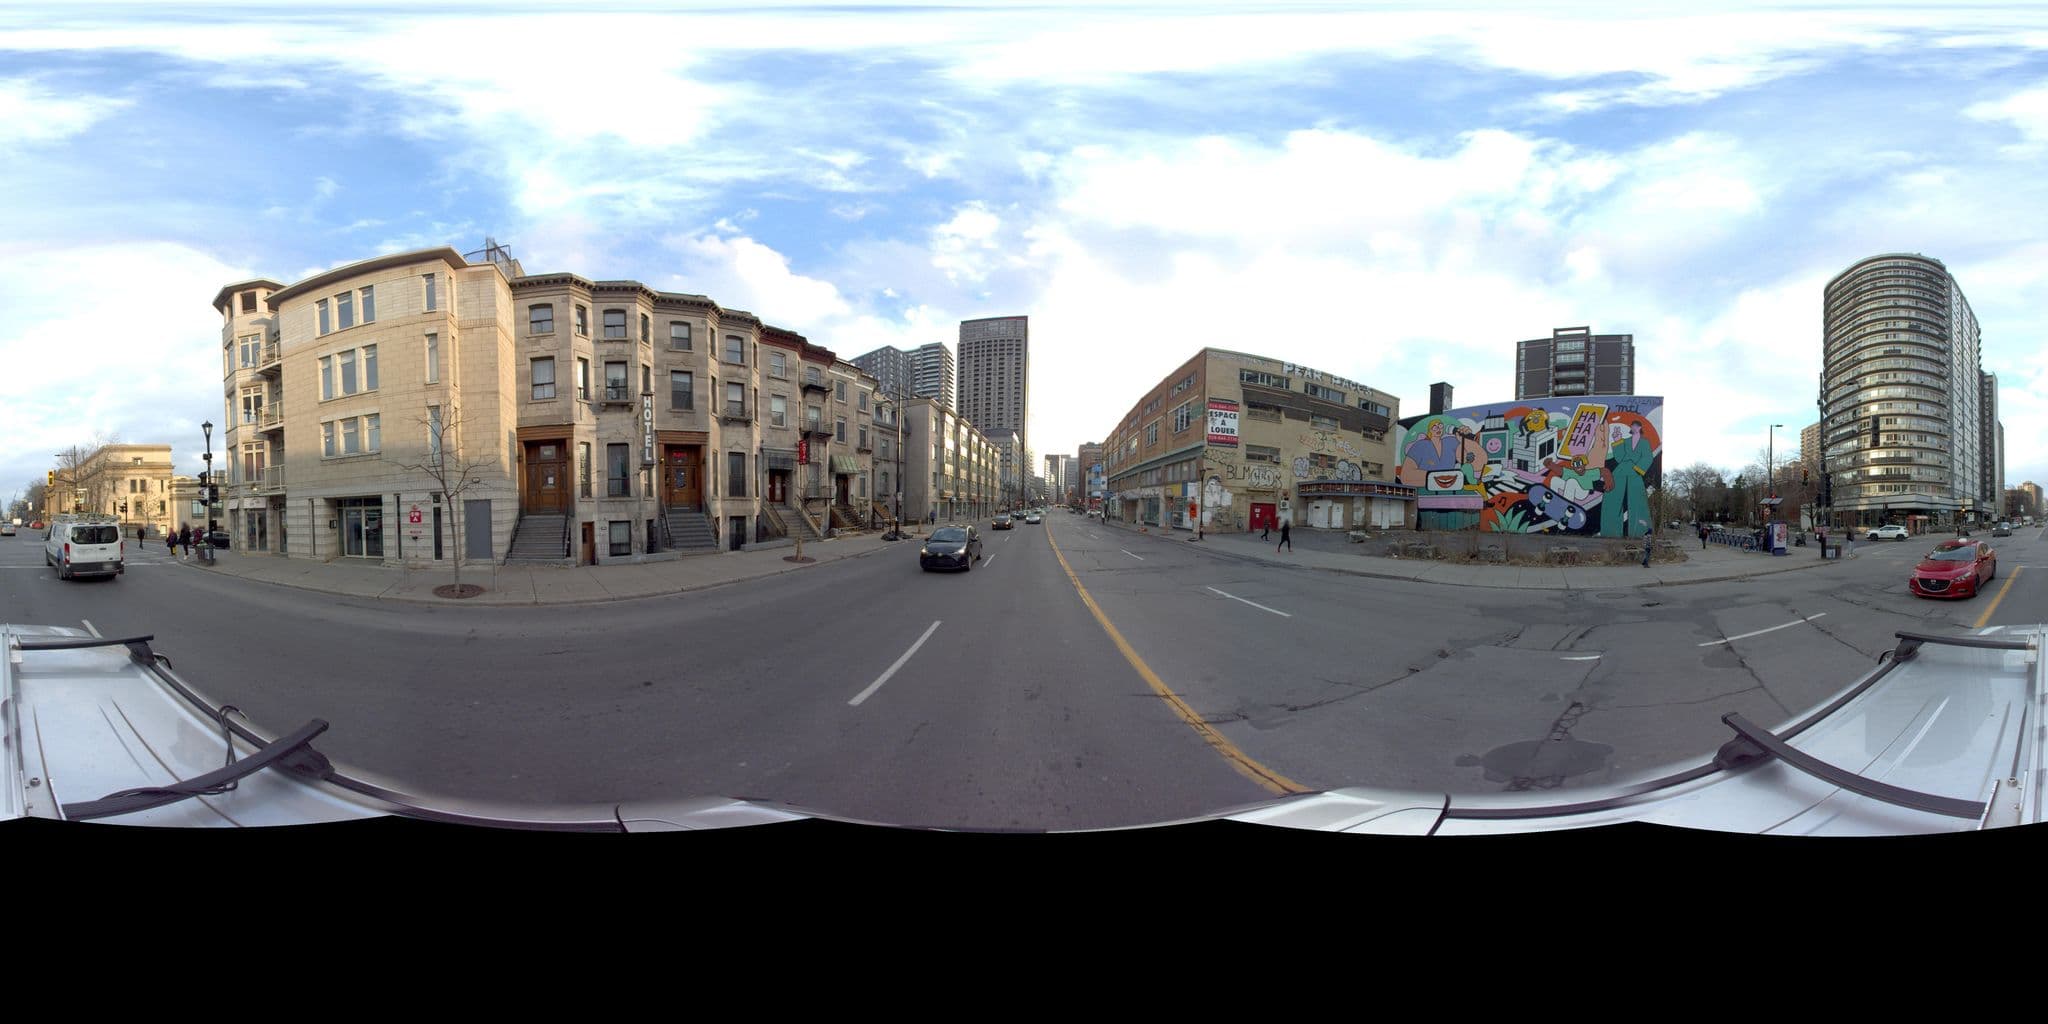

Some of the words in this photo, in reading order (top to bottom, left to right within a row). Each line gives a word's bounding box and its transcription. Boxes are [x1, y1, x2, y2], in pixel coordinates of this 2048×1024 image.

[1209, 410, 1237, 419] ESPACE
[1578, 411, 1596, 423] HA
[643, 396, 652, 461] HOTEL
[1211, 426, 1236, 434] LOUER
[1572, 422, 1591, 435] HA
[1567, 434, 1586, 447] HA
[1227, 464, 1250, 479] BLM
